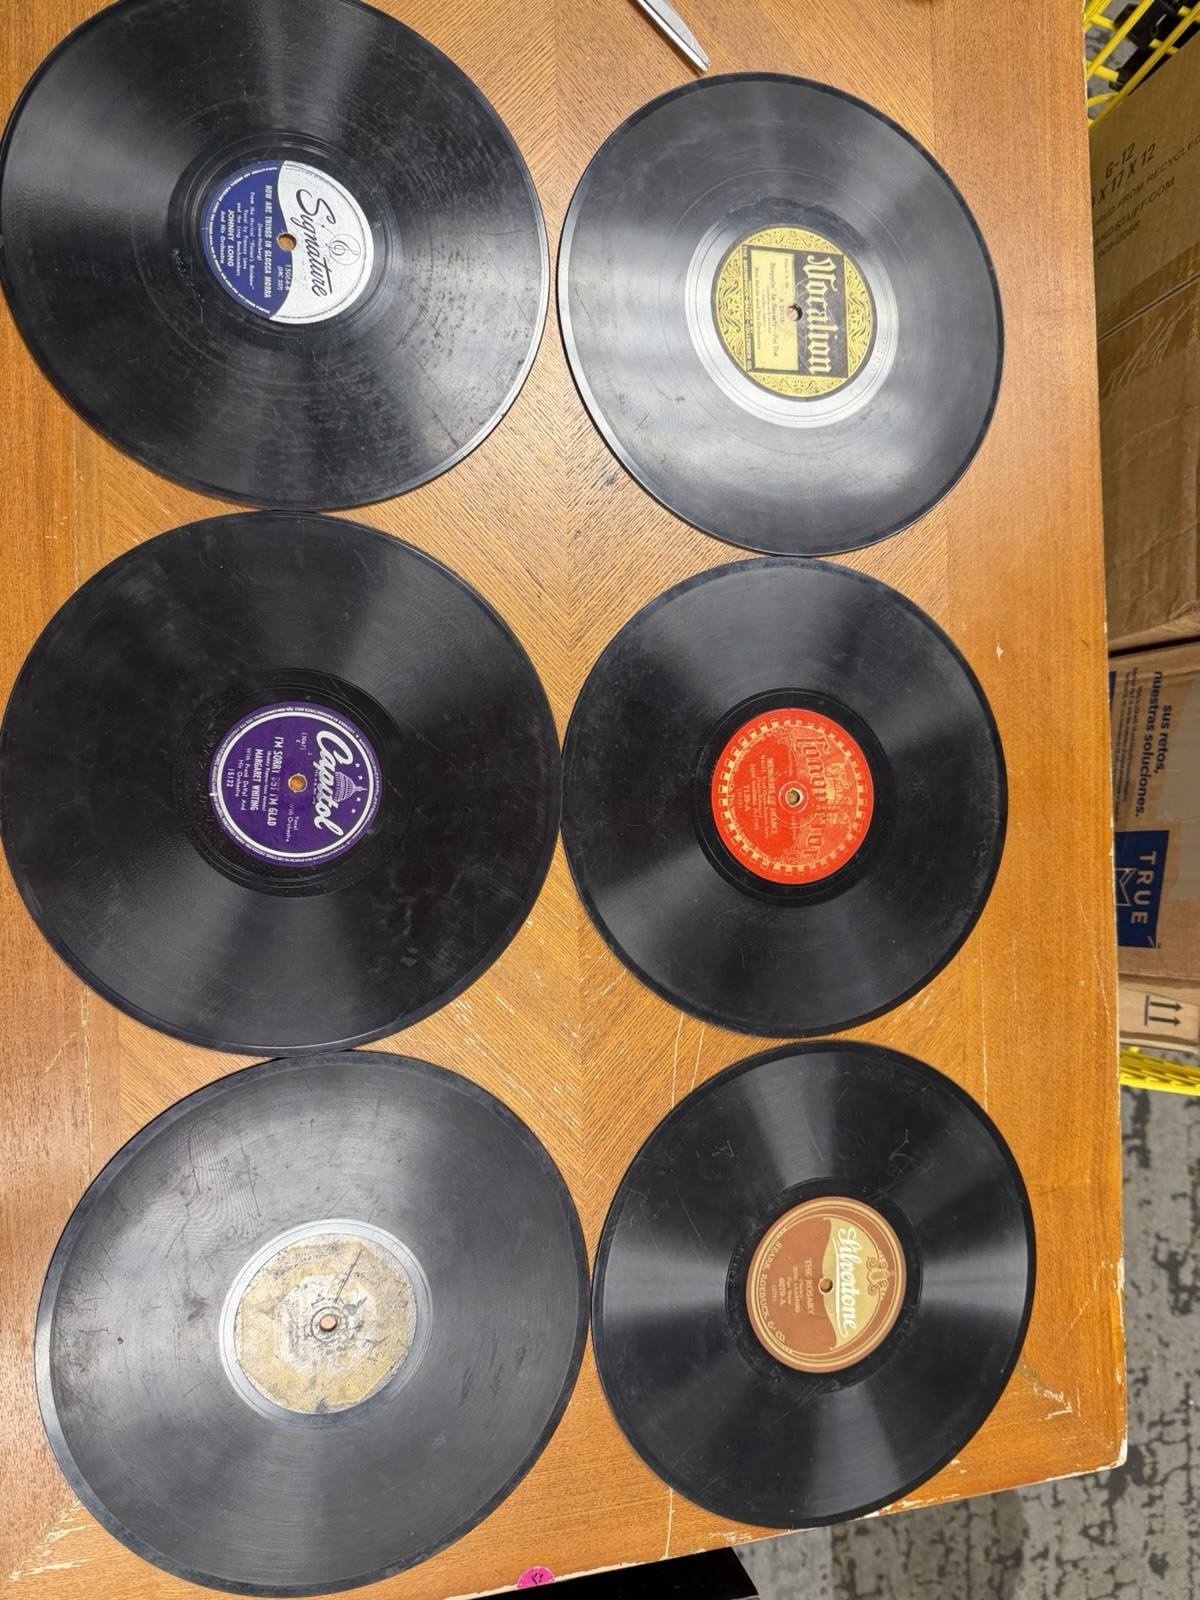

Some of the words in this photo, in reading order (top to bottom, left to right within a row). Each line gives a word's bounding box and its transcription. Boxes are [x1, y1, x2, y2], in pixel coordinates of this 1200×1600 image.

[1106, 142, 1135, 179] G-12
[1112, 169, 1124, 193] 17
[1127, 158, 1137, 179] X
[1141, 143, 1156, 166] 12
[265, 185, 273, 199] HOW
[265, 201, 273, 213] ARE
[264, 216, 273, 238] THINGS
[290, 189, 336, 297] Signature
[264, 250, 272, 274] GLOCCA
[264, 276, 272, 298] MORRA
[802, 255, 839, 375] Vocalion
[1146, 671, 1163, 731] nuestras
[1160, 705, 1173, 729] sus
[274, 736, 284, 748] I'M
[1153, 732, 1170, 774] retos,
[243, 764, 251, 778] Frank
[252, 748, 263, 782] MARGARET
[271, 750, 283, 773] SORRY
[227, 768, 235, 787] 15122
[235, 771, 243, 797] Orchestra
[313, 730, 354, 836] Capitol
[766, 757, 775, 794] MEMORIES
[1135, 734, 1154, 818] soluciones.
[250, 785, 260, 811] WHITING
[269, 793, 278, 805] I'M
[267, 808, 278, 826] GLAD
[285, 817, 294, 842] Orchestra
[770, 807, 778, 835] FRANCE
[1130, 850, 1157, 924] TRUE
[833, 1227, 862, 1338] Silvertone
[805, 1279, 814, 1315] ROSARY
